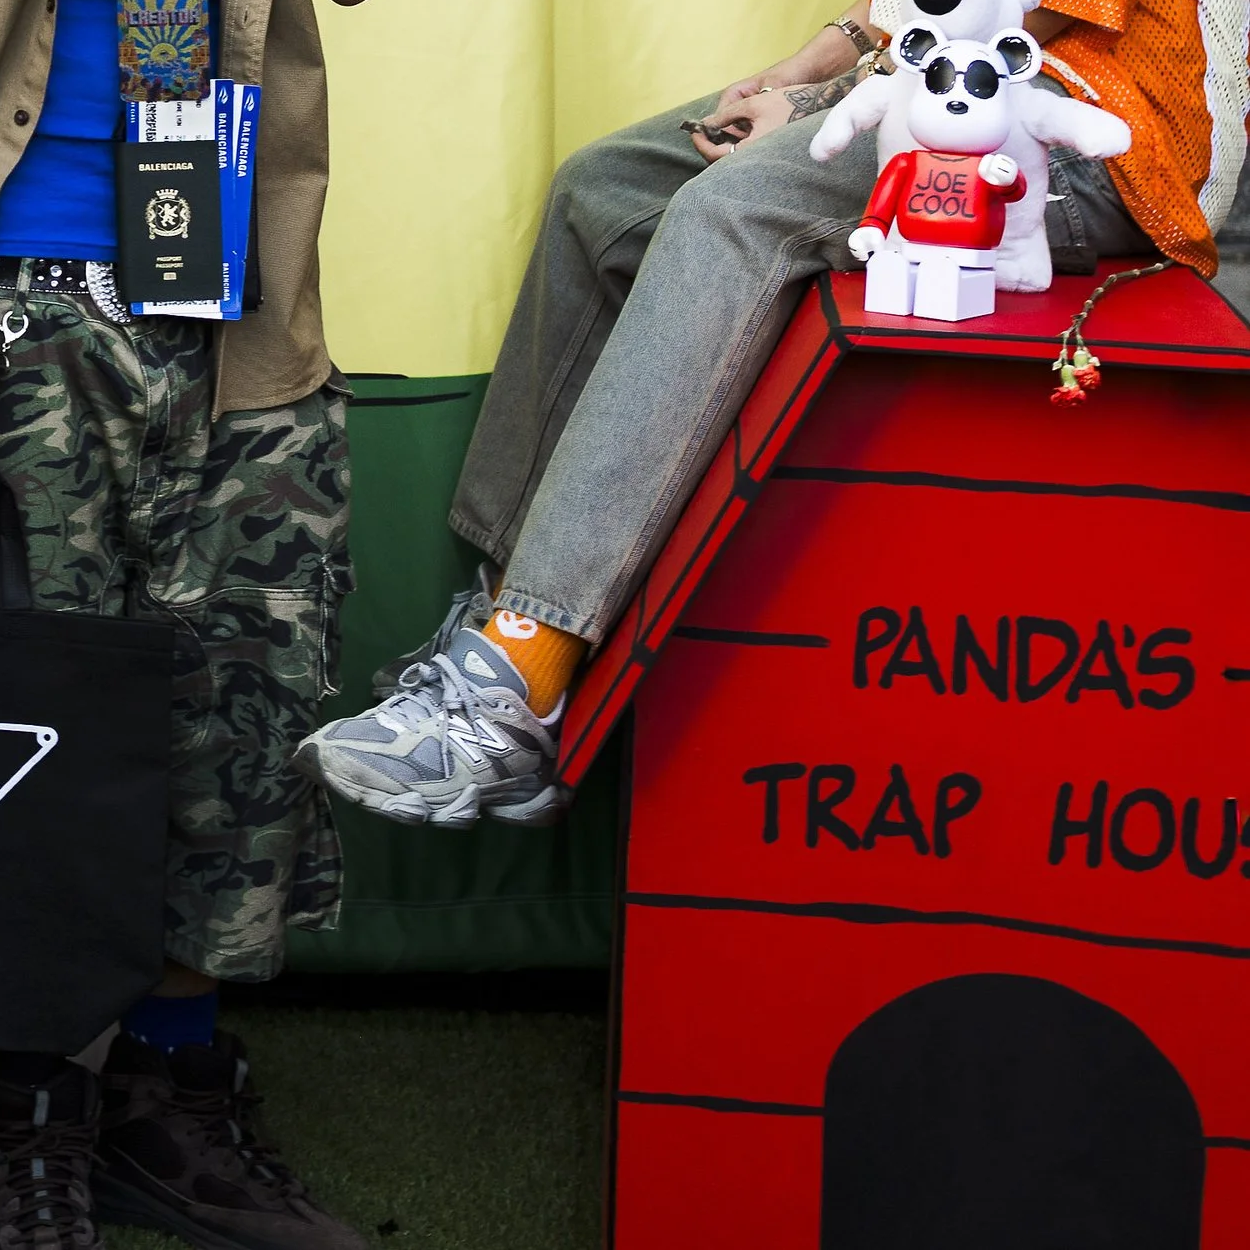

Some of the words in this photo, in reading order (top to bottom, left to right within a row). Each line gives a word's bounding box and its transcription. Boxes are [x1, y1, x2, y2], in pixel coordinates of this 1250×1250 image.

[127, 8, 200, 26] CREATOR
[218, 113, 227, 169] BALENCIAGA
[237, 120, 252, 178] BALENCIAGA
[138, 162, 194, 172] BALENCIAGA
[916, 169, 967, 194] JOE
[908, 193, 975, 218] COOL
[222, 262, 231, 302] BALENCIAGA
[853, 606, 1195, 711] PANDA'S
[743, 762, 982, 859] TRAP
[1048, 780, 1250, 880] HOU
